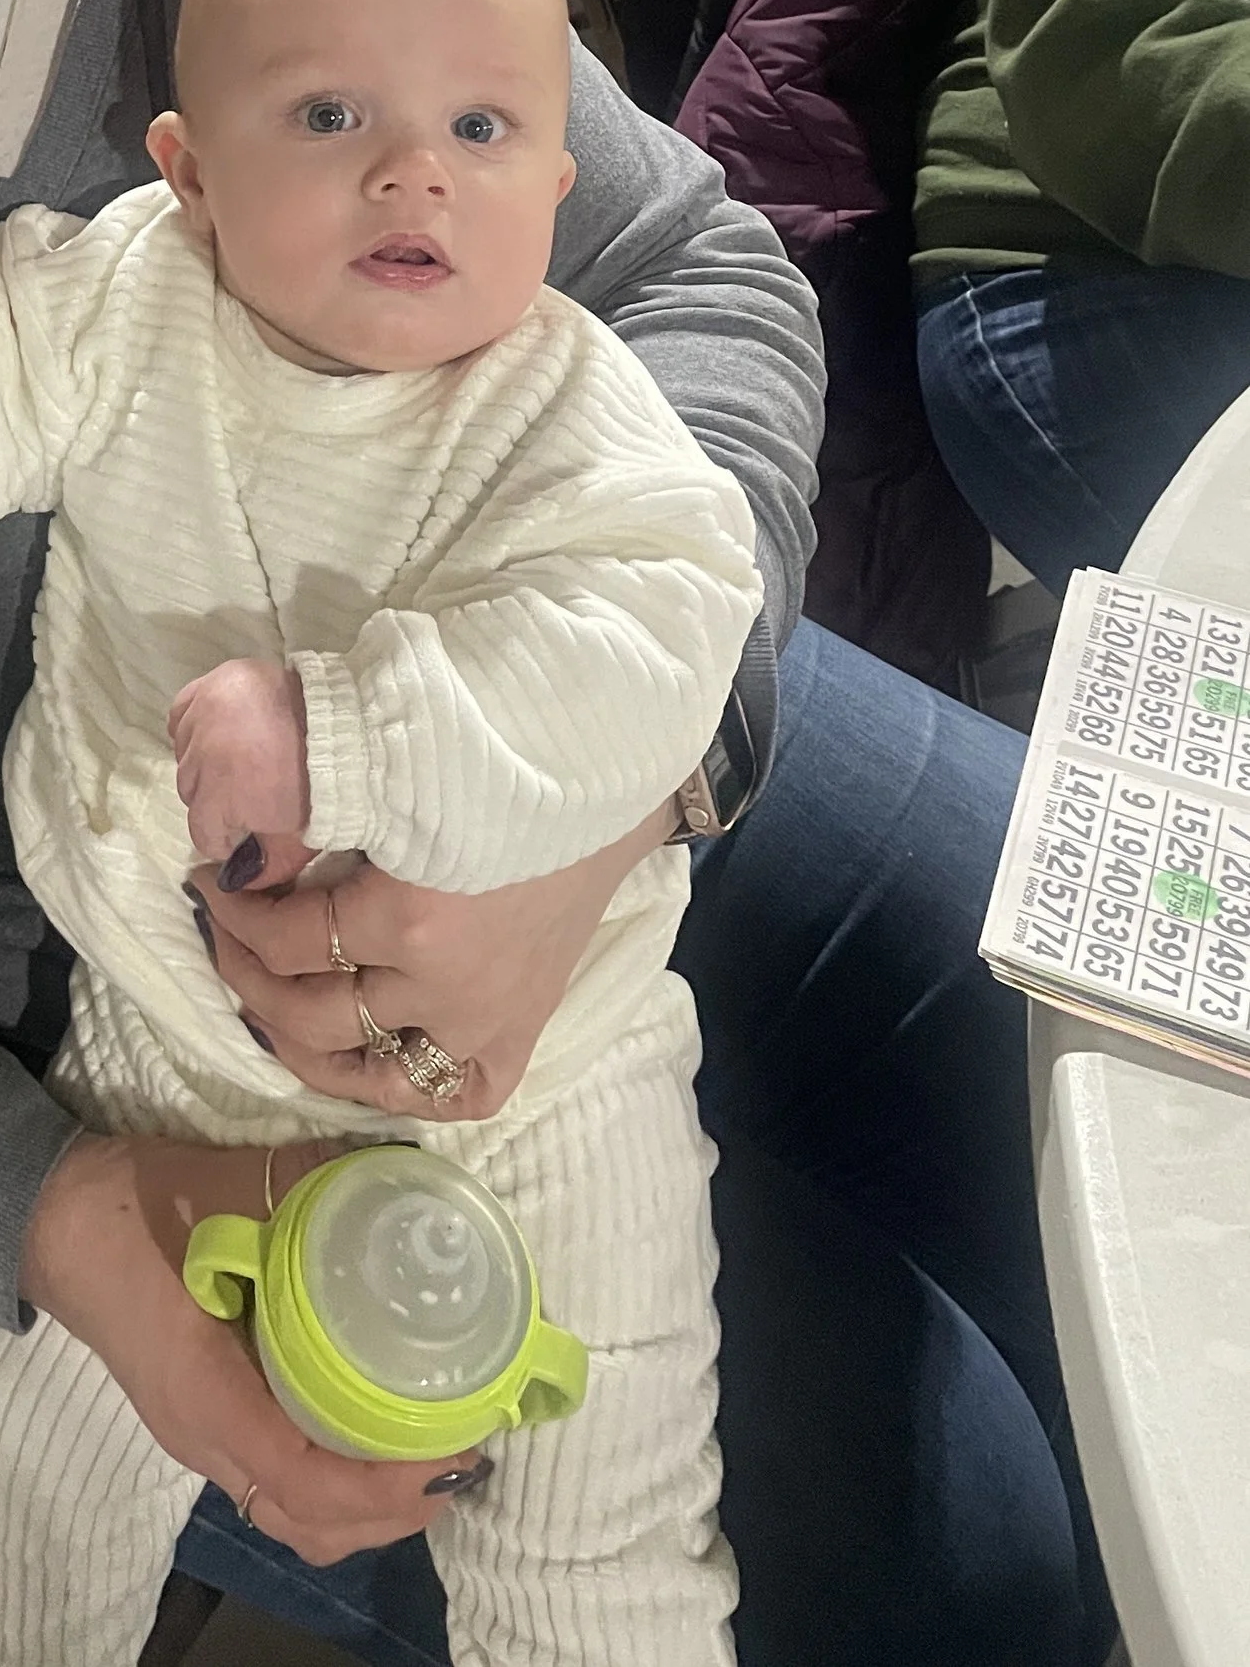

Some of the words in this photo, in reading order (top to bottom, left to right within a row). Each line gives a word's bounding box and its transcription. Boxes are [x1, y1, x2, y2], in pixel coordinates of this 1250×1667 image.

[1109, 588, 1144, 614] 11
[1158, 607, 1192, 624] 4
[1102, 615, 1137, 649] 20
[1151, 630, 1187, 664] 28
[1207, 614, 1243, 645] 13
[1093, 649, 1129, 681] 44
[1201, 644, 1238, 677] 21
[1085, 681, 1123, 715] 52
[1144, 664, 1180, 698] 36
[1078, 714, 1115, 746] 68
[1137, 697, 1174, 730] 59
[1188, 712, 1226, 744] 51
[1130, 730, 1168, 764] 75
[1182, 746, 1221, 780] 65
[1065, 764, 1104, 801] 14
[1119, 788, 1156, 810] 9
[1057, 799, 1096, 840] 27
[1172, 797, 1211, 838] 15
[1110, 817, 1150, 856] 19
[1045, 839, 1087, 879] 42
[1164, 835, 1204, 877] 25
[1101, 857, 1142, 898] 40
[1166, 874, 1189, 918] 20799
[1037, 879, 1079, 924] 57
[1091, 898, 1135, 942] 53
[1187, 888, 1204, 916] FREE
[1213, 895, 1250, 938] 39
[1026, 922, 1069, 962] 74
[1149, 917, 1191, 962] 59
[1083, 942, 1125, 982] 65
[1205, 938, 1248, 982] 49
[1141, 961, 1182, 998] 71
[1199, 981, 1241, 1022] 73
